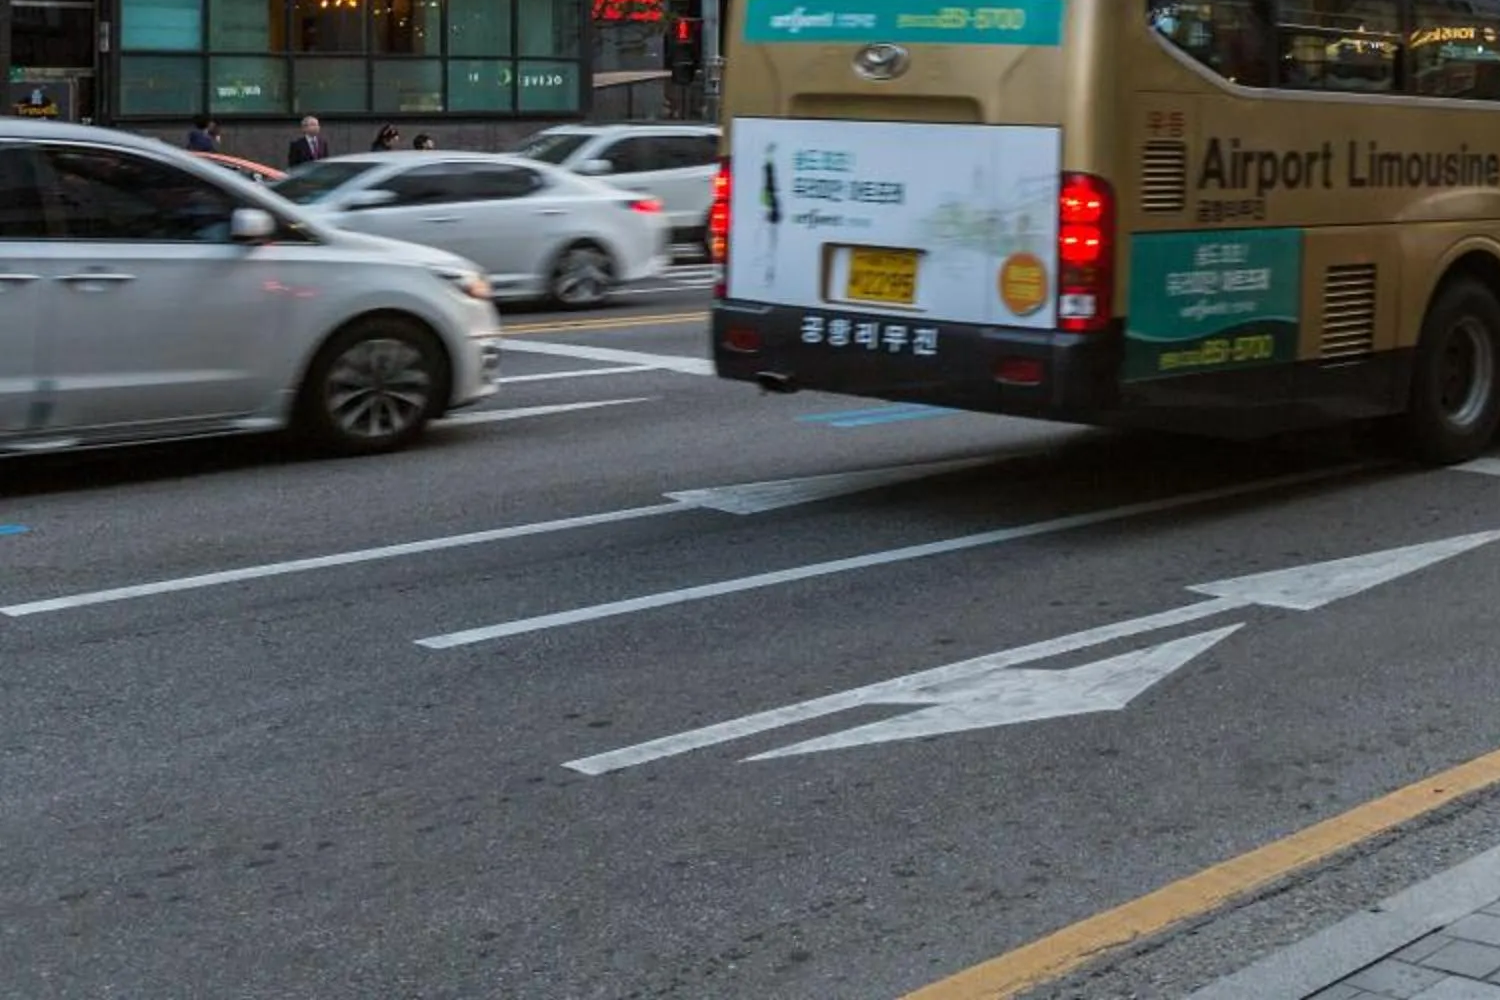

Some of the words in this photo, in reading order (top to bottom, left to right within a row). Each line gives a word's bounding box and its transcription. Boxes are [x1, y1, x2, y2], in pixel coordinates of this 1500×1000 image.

[1197, 137, 1335, 197] Airport
[1346, 140, 1500, 189] Limousine
[801, 316, 939, 355] 공항리무진
